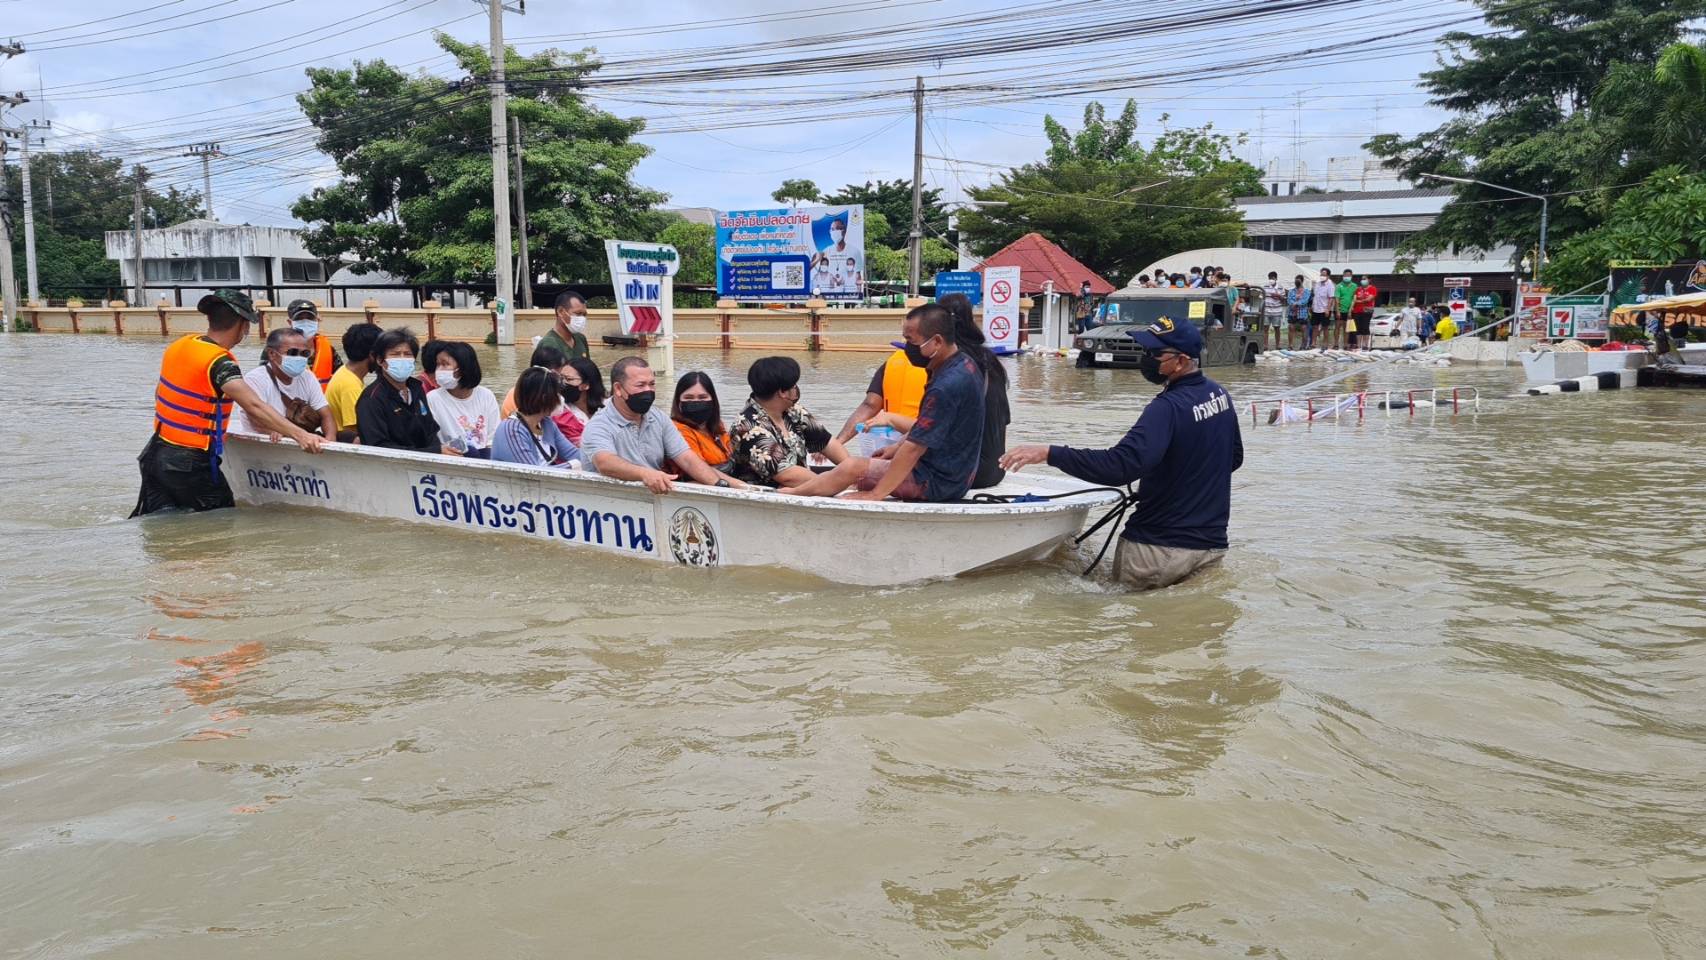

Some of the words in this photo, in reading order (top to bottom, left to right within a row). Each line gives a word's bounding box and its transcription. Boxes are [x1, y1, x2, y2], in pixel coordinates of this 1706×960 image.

[720, 211, 810, 227] ฉีดวัคซีนปลอดภัย
[626, 279, 643, 300] เข้า
[646, 284, 659, 300] IN
[1555, 311, 1570, 336] 7
[247, 464, 330, 499] กรมเจ้าท่า
[411, 474, 653, 552] เรือพระราชทาน
